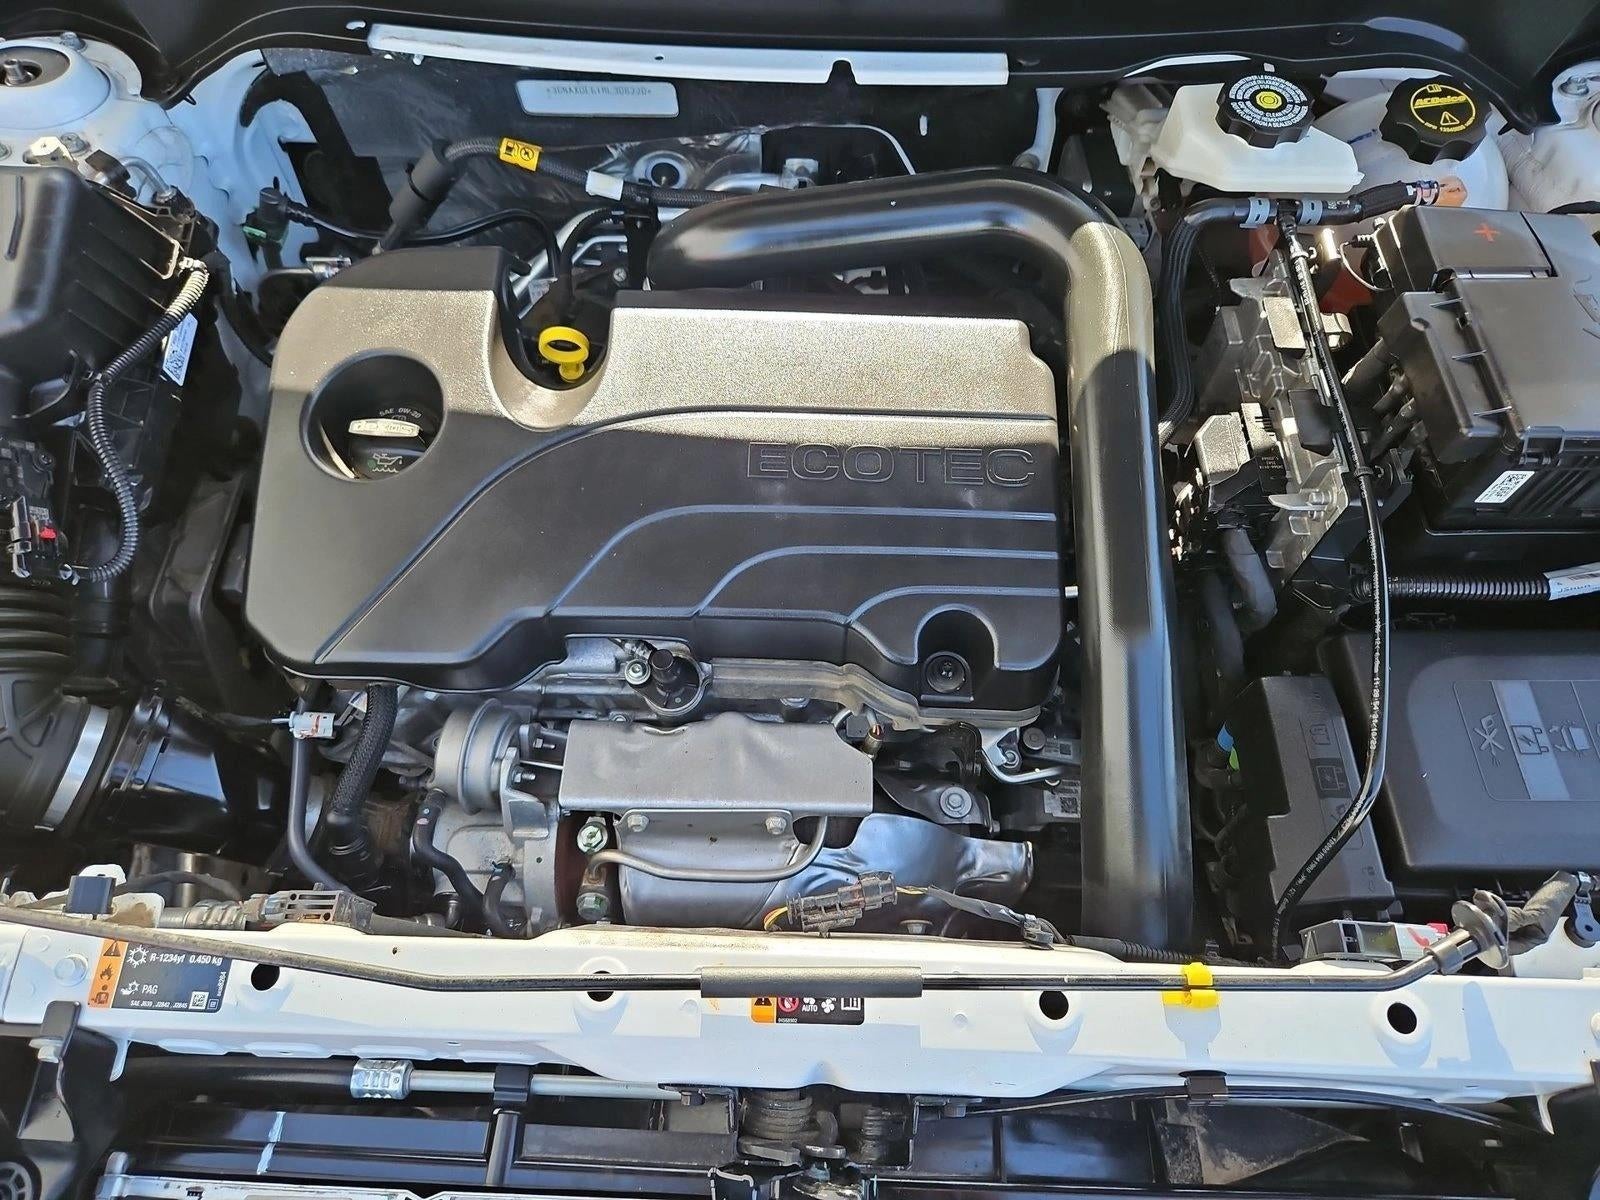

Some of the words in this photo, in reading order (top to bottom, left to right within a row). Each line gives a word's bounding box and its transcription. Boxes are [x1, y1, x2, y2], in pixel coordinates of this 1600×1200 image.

[379, 407, 395, 417] SAE
[747, 442, 1035, 487] ECOTEC
[189, 953, 211, 965] 0.450
[212, 956, 223, 967] kg
[142, 984, 159, 995] PAG
[802, 1004, 818, 1012] AUTO
